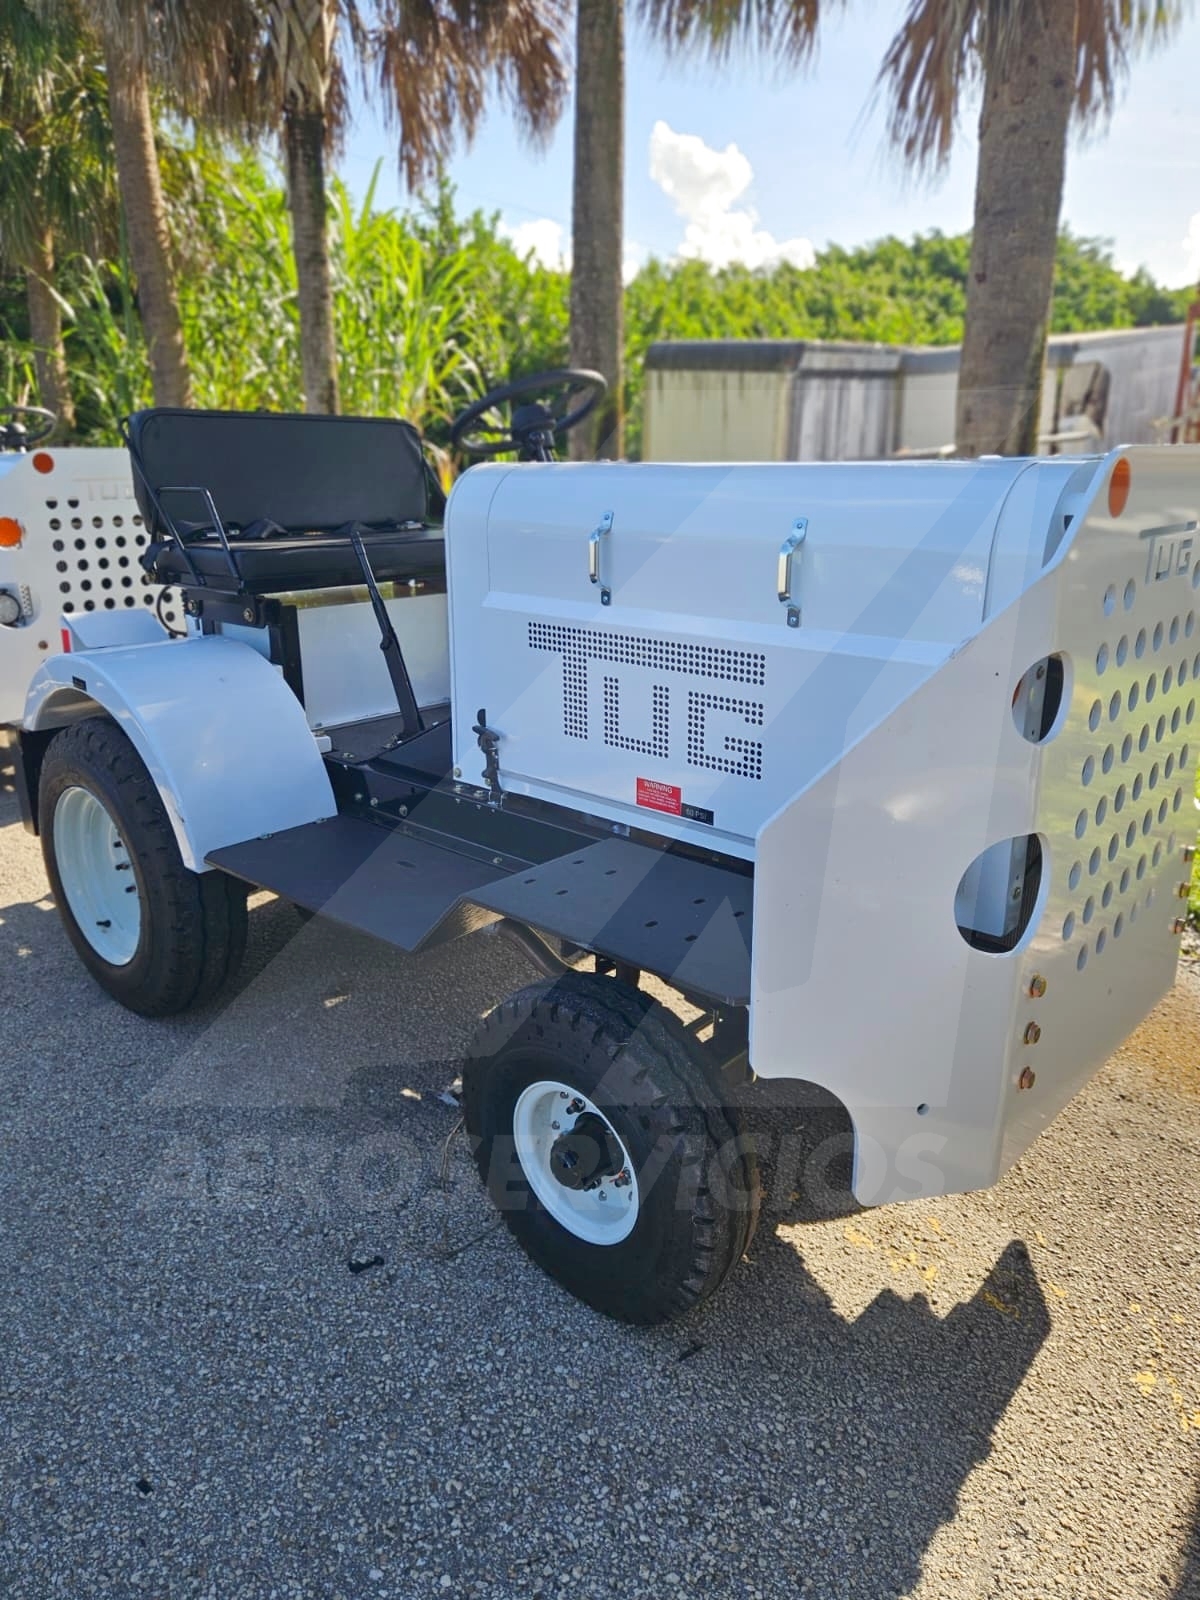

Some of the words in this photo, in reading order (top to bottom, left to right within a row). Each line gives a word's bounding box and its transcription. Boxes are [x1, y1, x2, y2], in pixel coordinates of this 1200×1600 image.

[1139, 520, 1198, 585] TUG
[528, 621, 766, 780] TUG
[643, 780, 673, 794] WARNING
